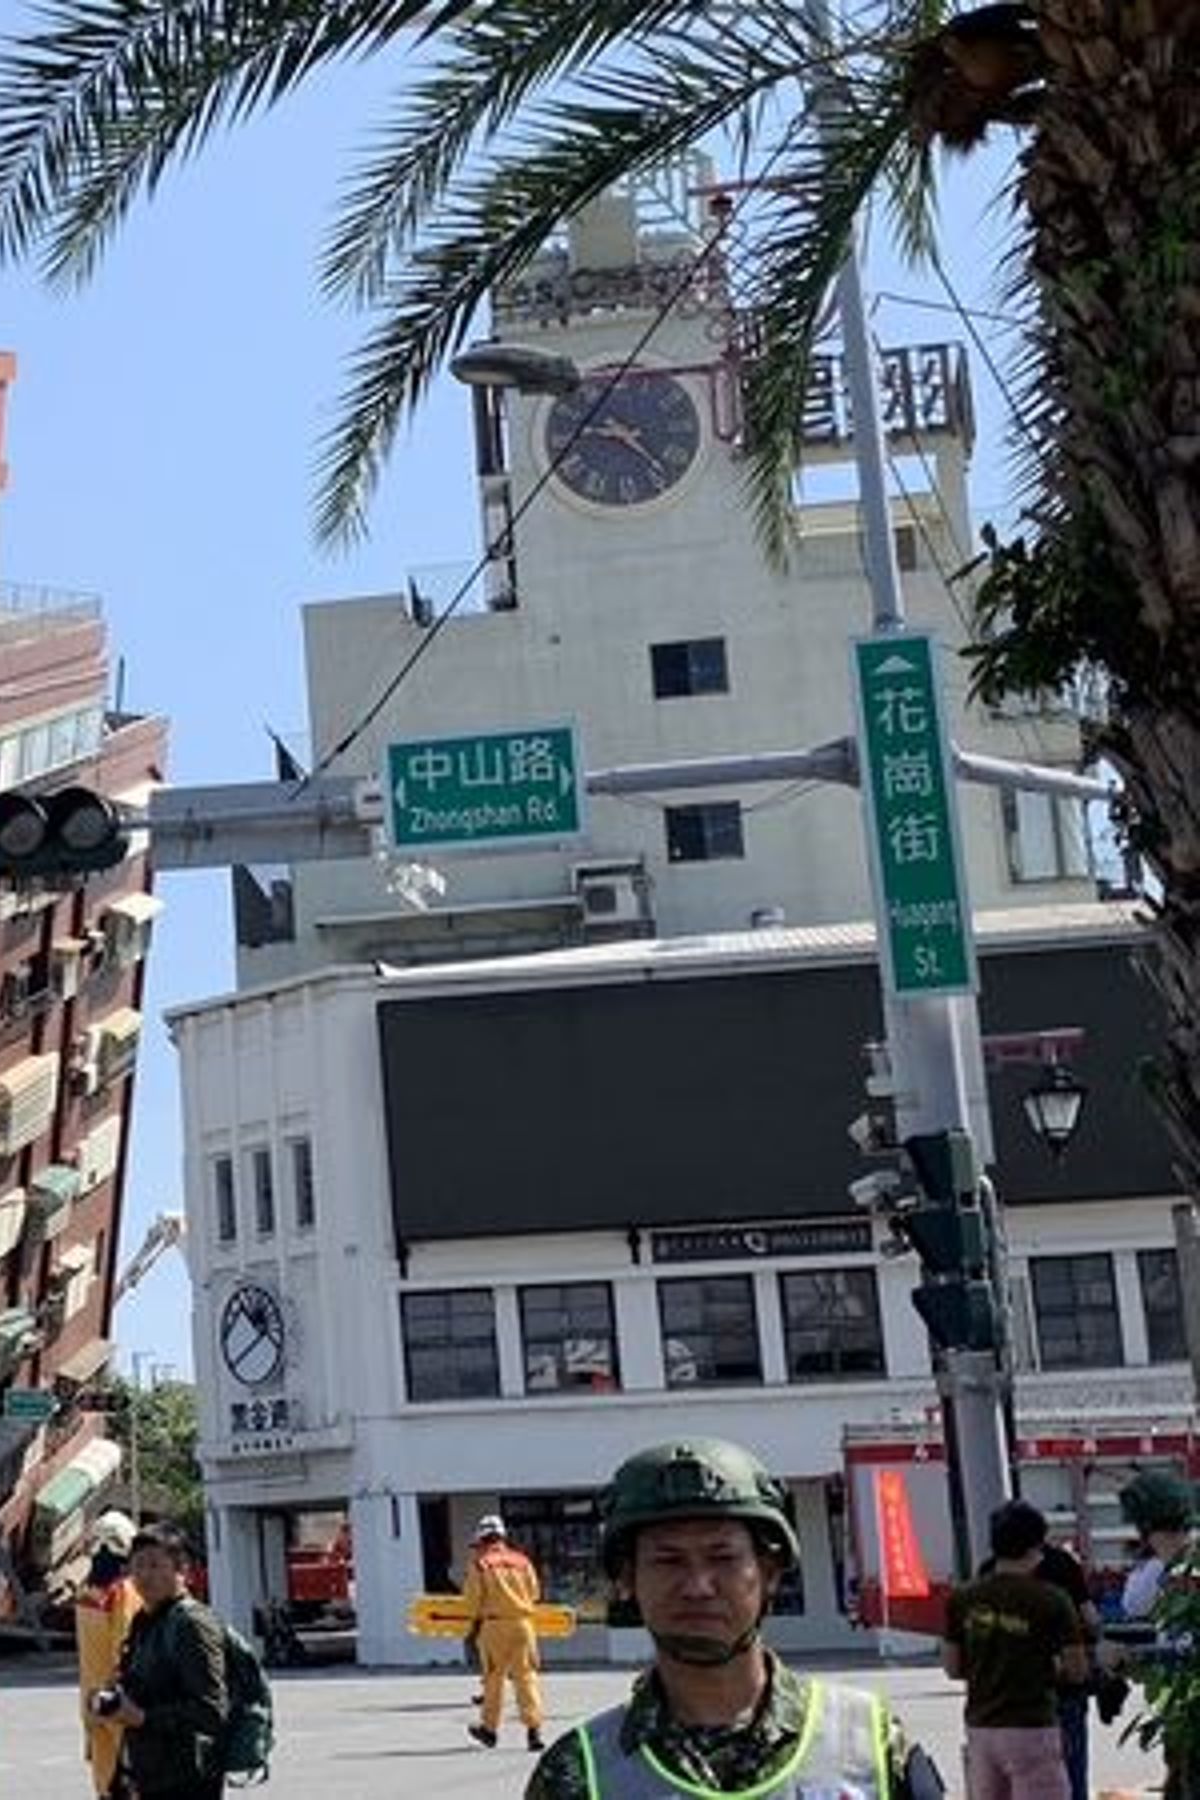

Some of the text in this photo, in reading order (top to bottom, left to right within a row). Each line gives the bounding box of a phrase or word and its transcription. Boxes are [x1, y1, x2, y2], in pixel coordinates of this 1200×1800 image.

[408, 737, 554, 791] 中山路
[875, 686, 939, 865] 花崗街
[410, 804, 523, 835] Zhongshan
